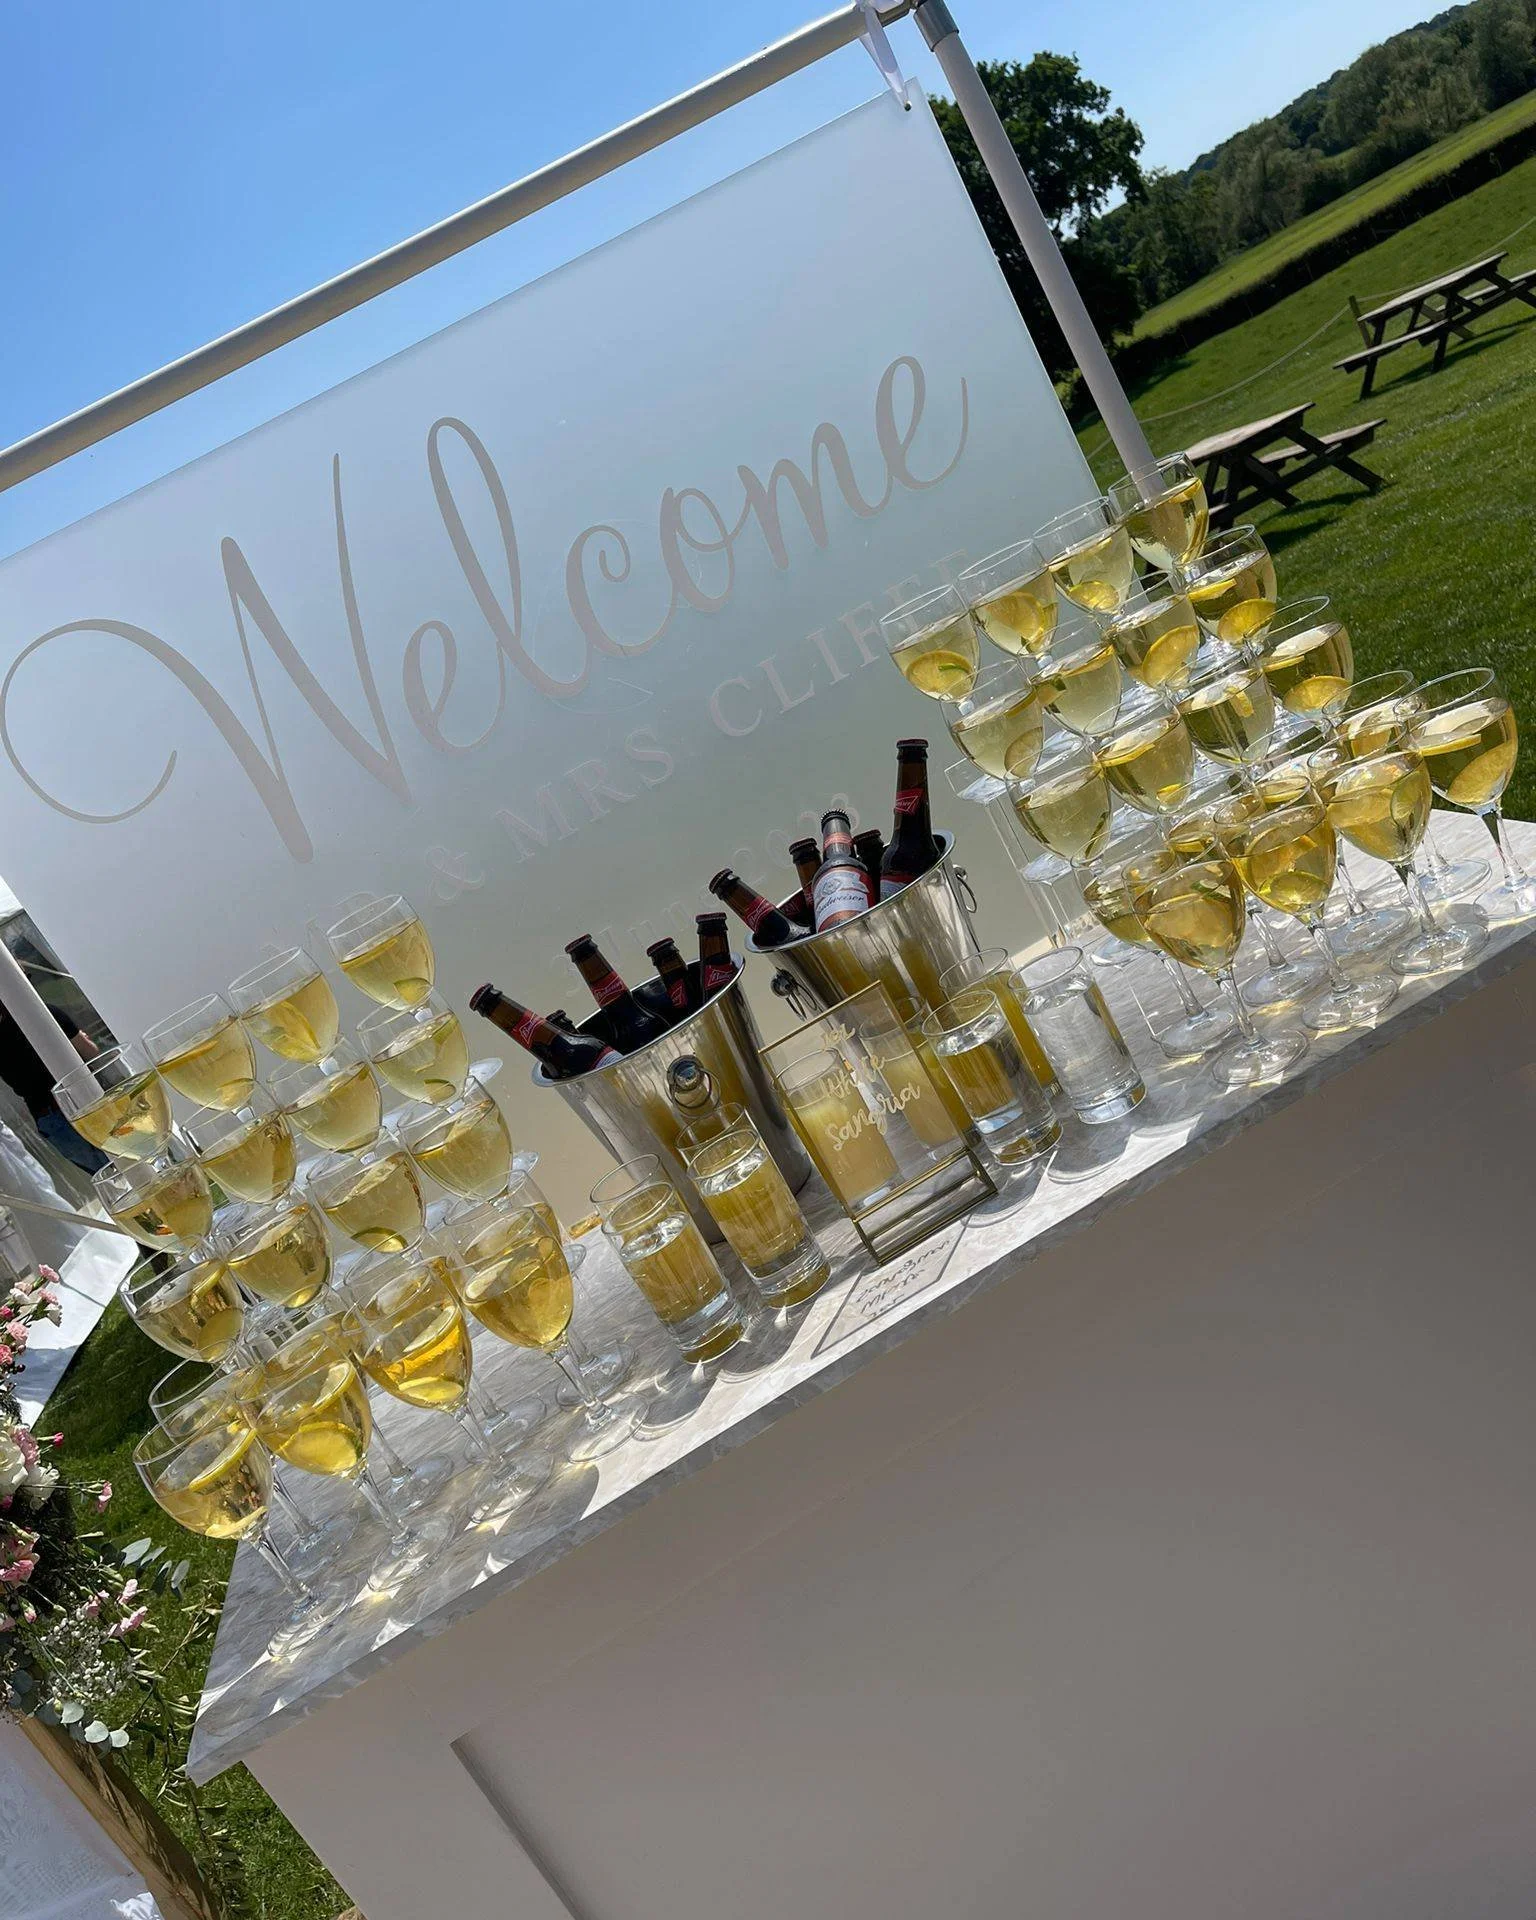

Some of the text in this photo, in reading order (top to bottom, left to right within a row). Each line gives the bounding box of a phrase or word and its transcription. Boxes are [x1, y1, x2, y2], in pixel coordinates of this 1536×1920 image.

[1, 354, 969, 863] Welcome
[491, 722, 677, 864] MRS
[821, 1055, 885, 1098] Whte
[824, 1081, 921, 1151] Sangria
